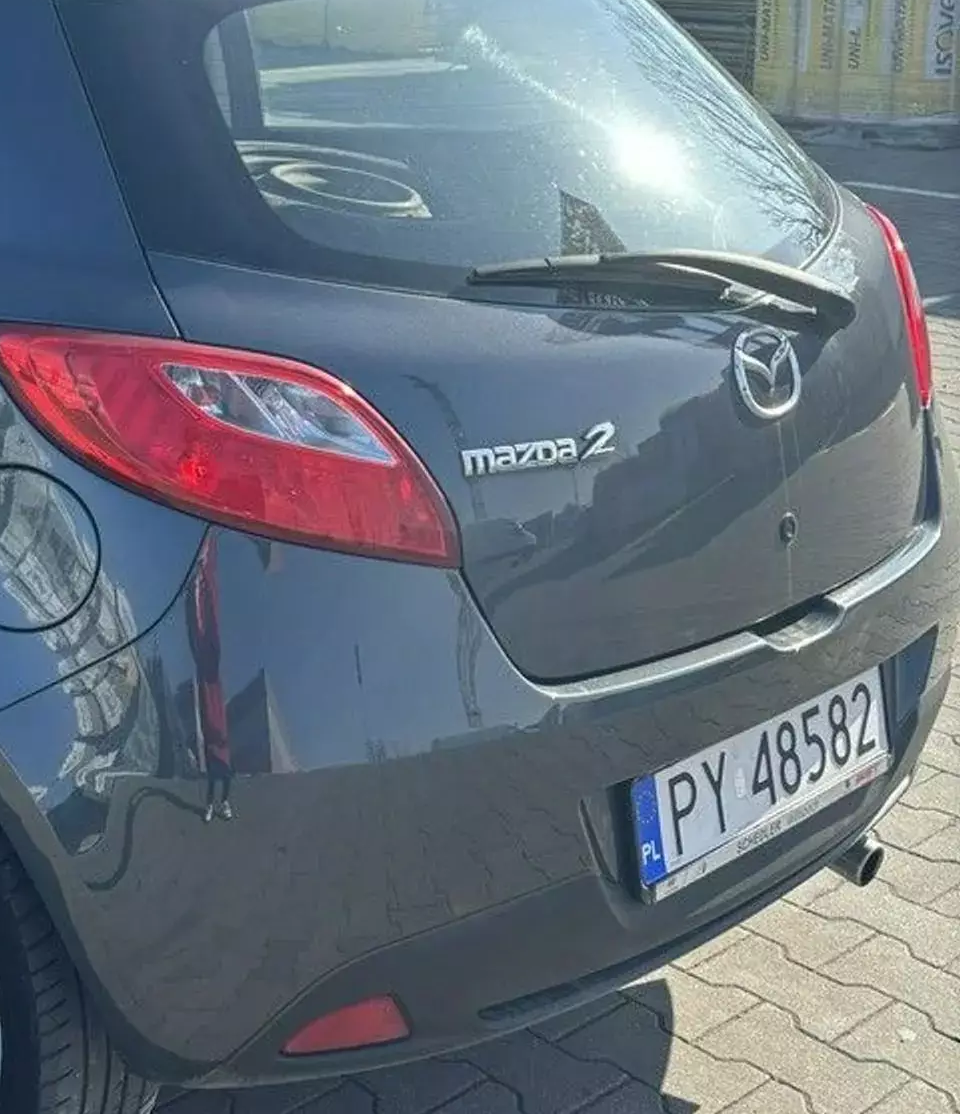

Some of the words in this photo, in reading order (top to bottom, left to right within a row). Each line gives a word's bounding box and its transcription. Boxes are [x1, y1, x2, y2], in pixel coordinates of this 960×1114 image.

[460, 437, 578, 478] mazda
[576, 420, 616, 462] 2
[668, 751, 727, 855] PY
[752, 682, 877, 806] 48582
[642, 842, 662, 866] PL
